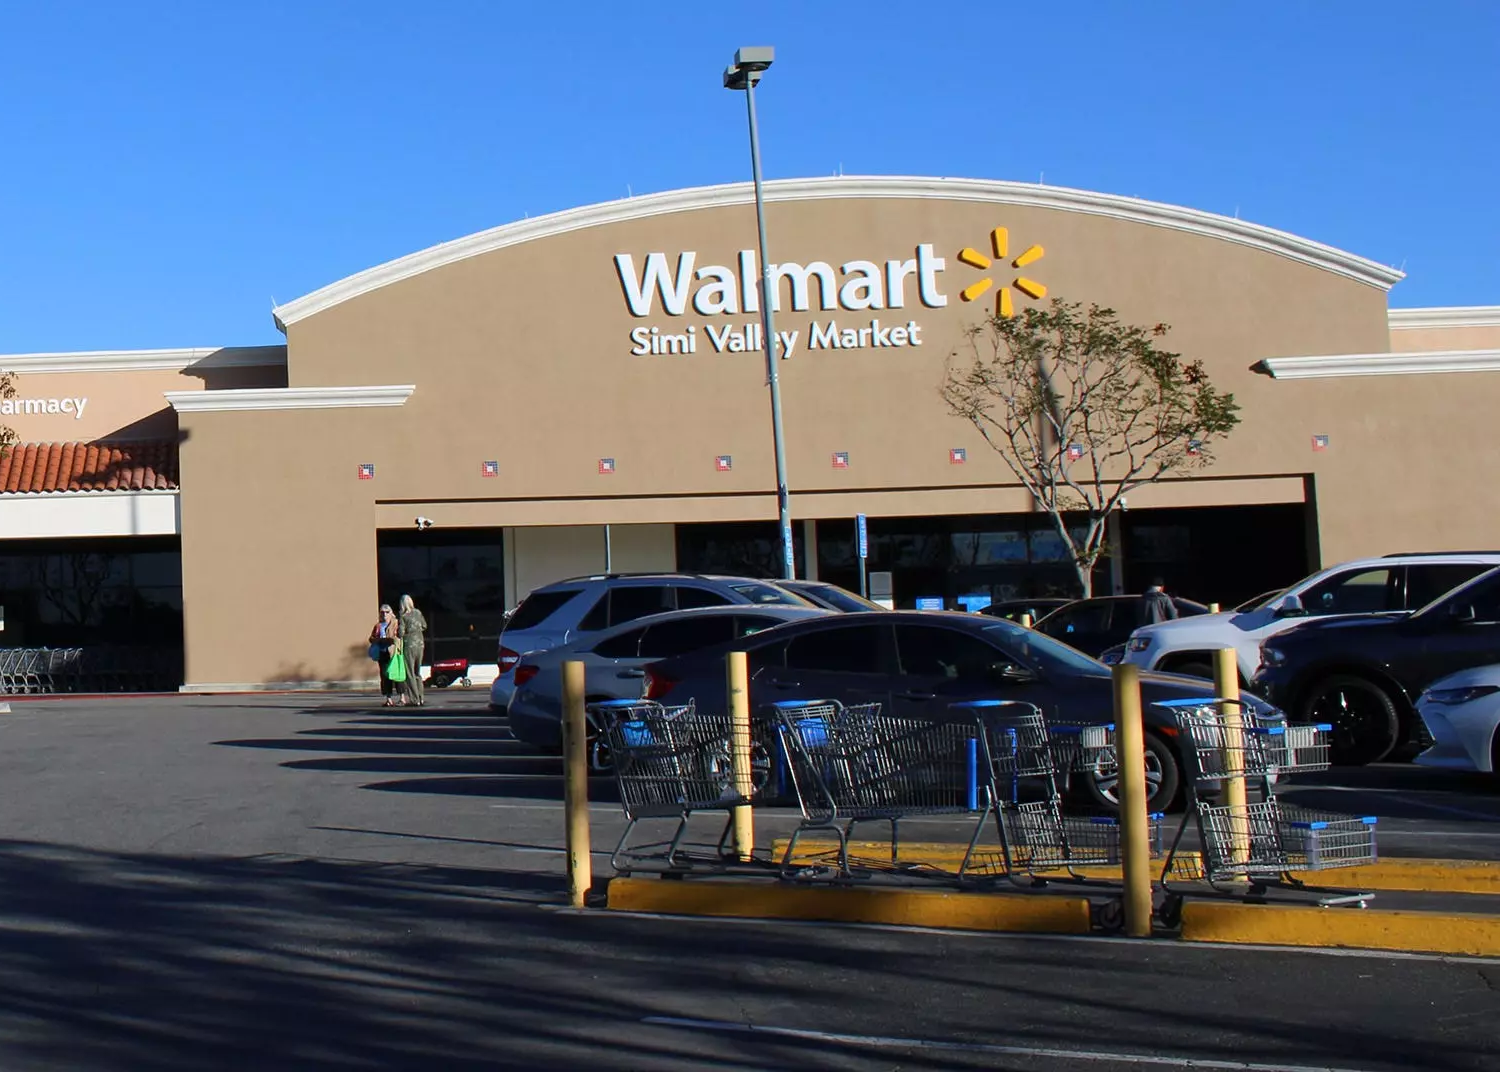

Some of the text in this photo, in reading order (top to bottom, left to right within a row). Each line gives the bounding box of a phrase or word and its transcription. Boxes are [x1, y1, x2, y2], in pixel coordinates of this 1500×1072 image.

[614, 243, 947, 316] Walmart
[630, 326, 696, 355] Simi
[807, 319, 922, 350] Market
